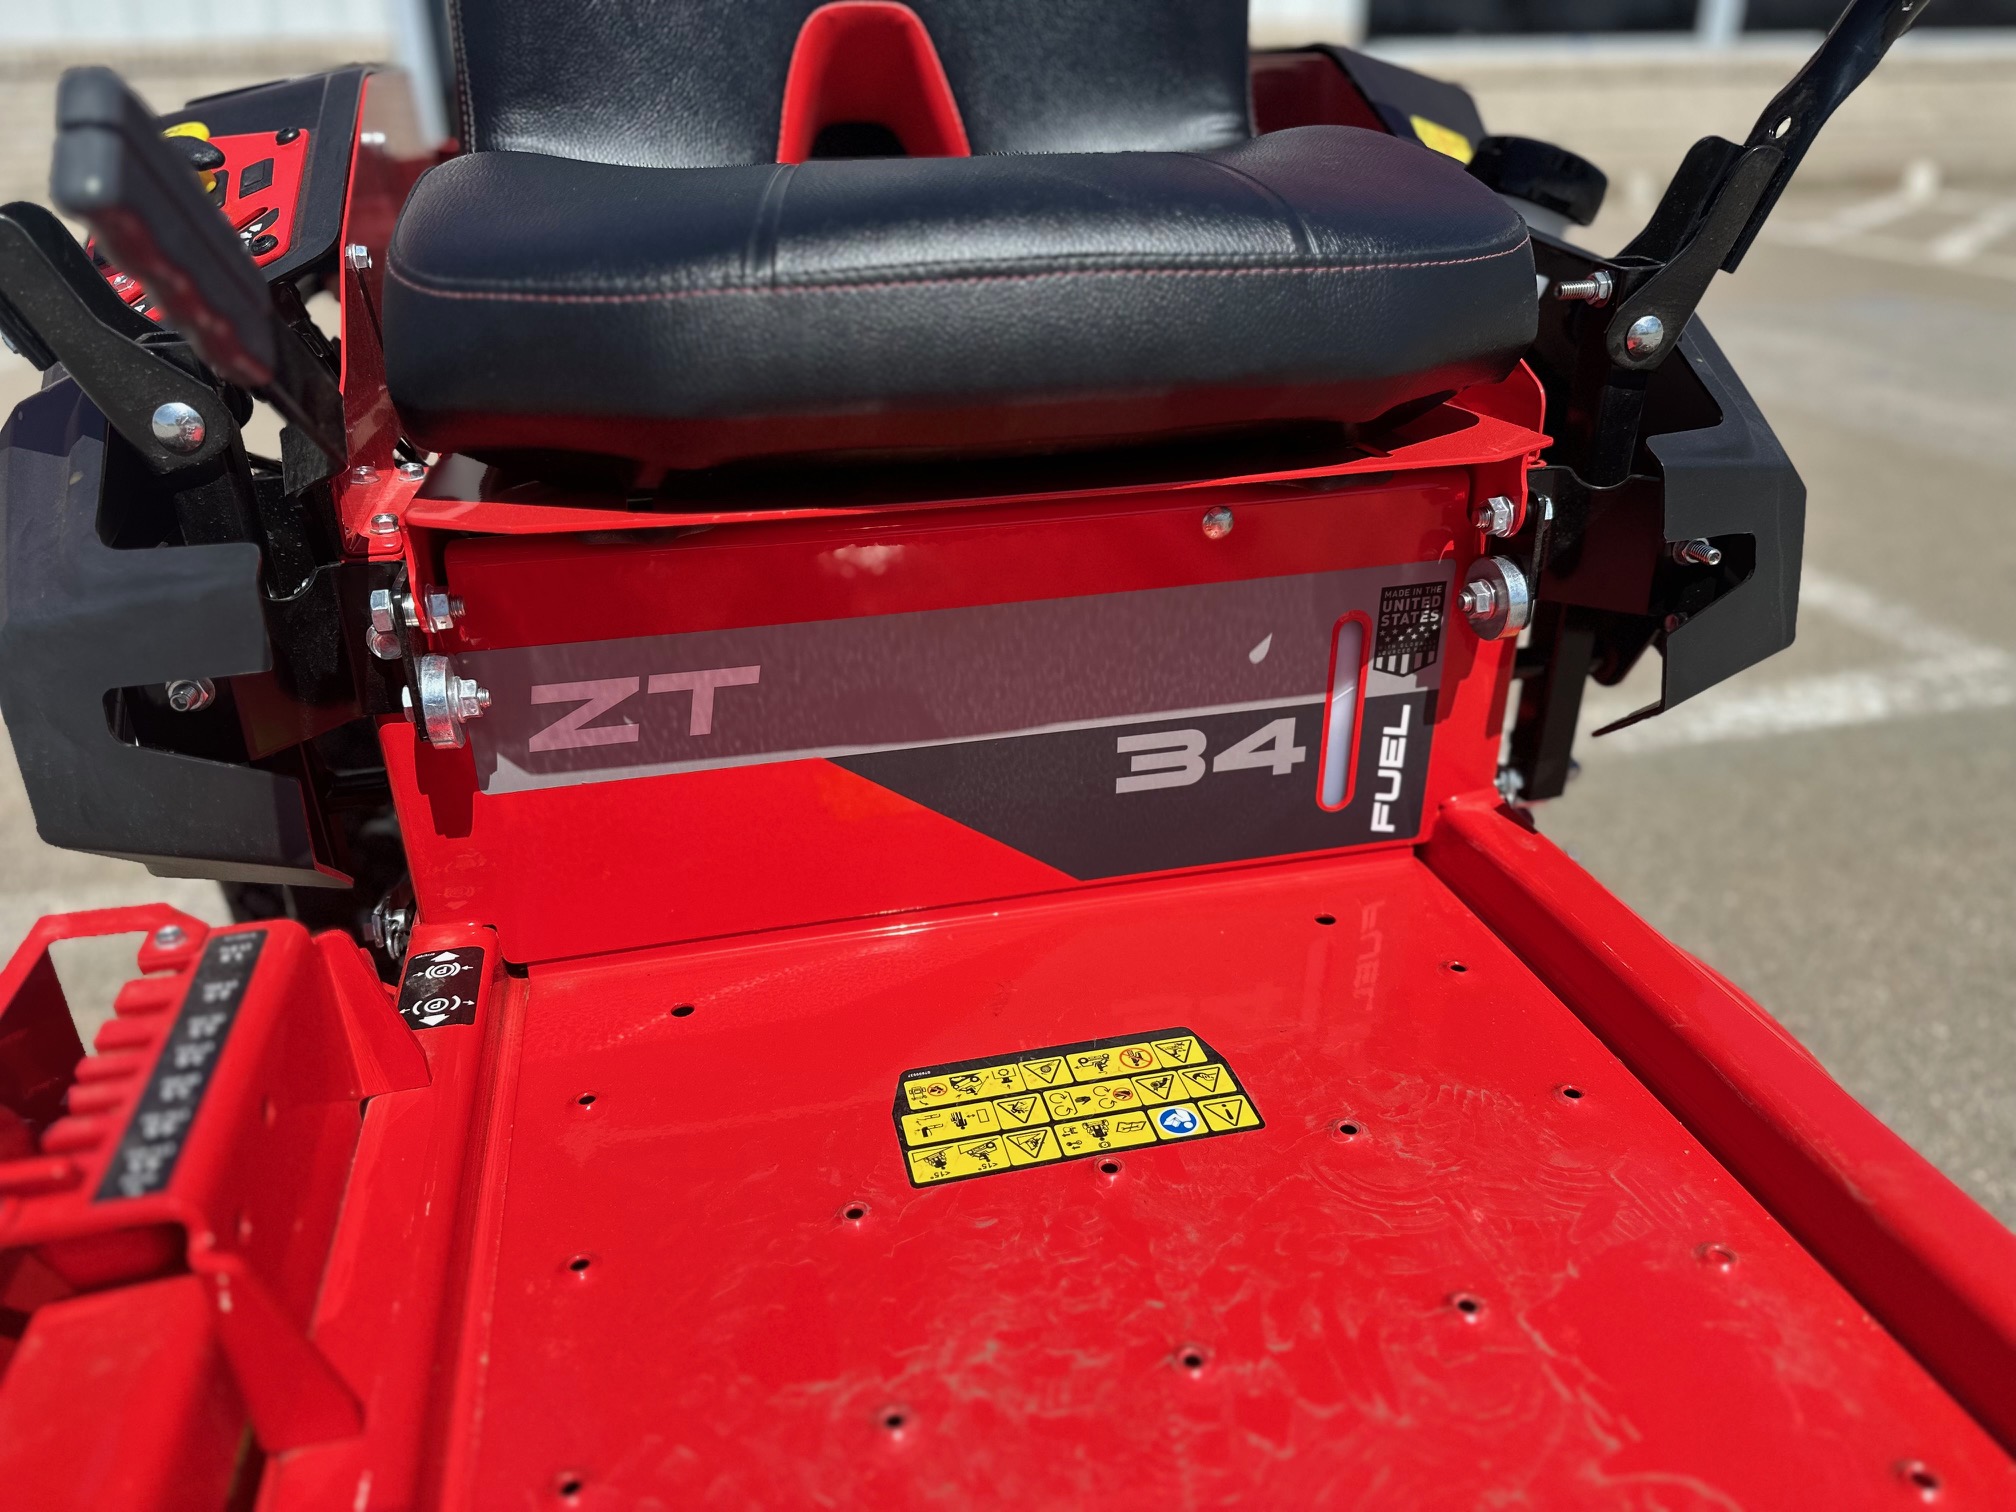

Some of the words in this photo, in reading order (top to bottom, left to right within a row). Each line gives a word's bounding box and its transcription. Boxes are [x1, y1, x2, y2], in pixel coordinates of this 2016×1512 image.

[1382, 595, 1442, 613] UNITED
[1384, 588, 1411, 598] MADE
[1412, 587, 1423, 596] IN
[1425, 585, 1443, 594] THE
[1380, 609, 1440, 627] STATES
[529, 665, 761, 753] ZT
[1115, 717, 1307, 794] 34
[1370, 704, 1411, 833] FUEL
